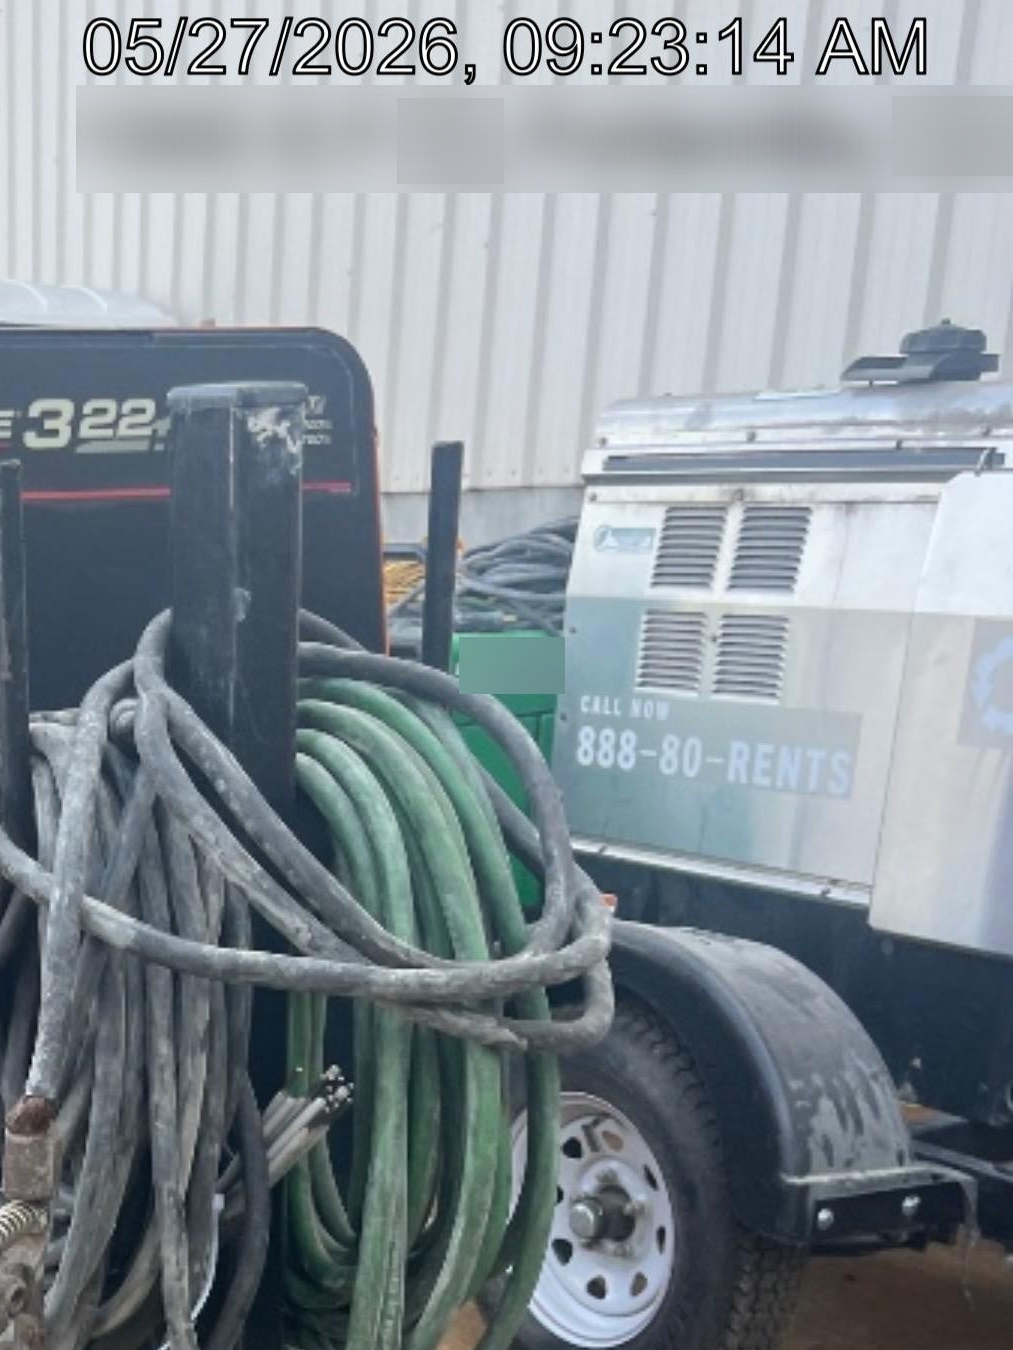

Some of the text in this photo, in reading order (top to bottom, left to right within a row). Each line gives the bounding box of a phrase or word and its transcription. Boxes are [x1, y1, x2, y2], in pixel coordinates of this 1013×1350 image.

[580, 695, 670, 720] CALL NOW
[576, 725, 852, 795] 888-80-RENTS
